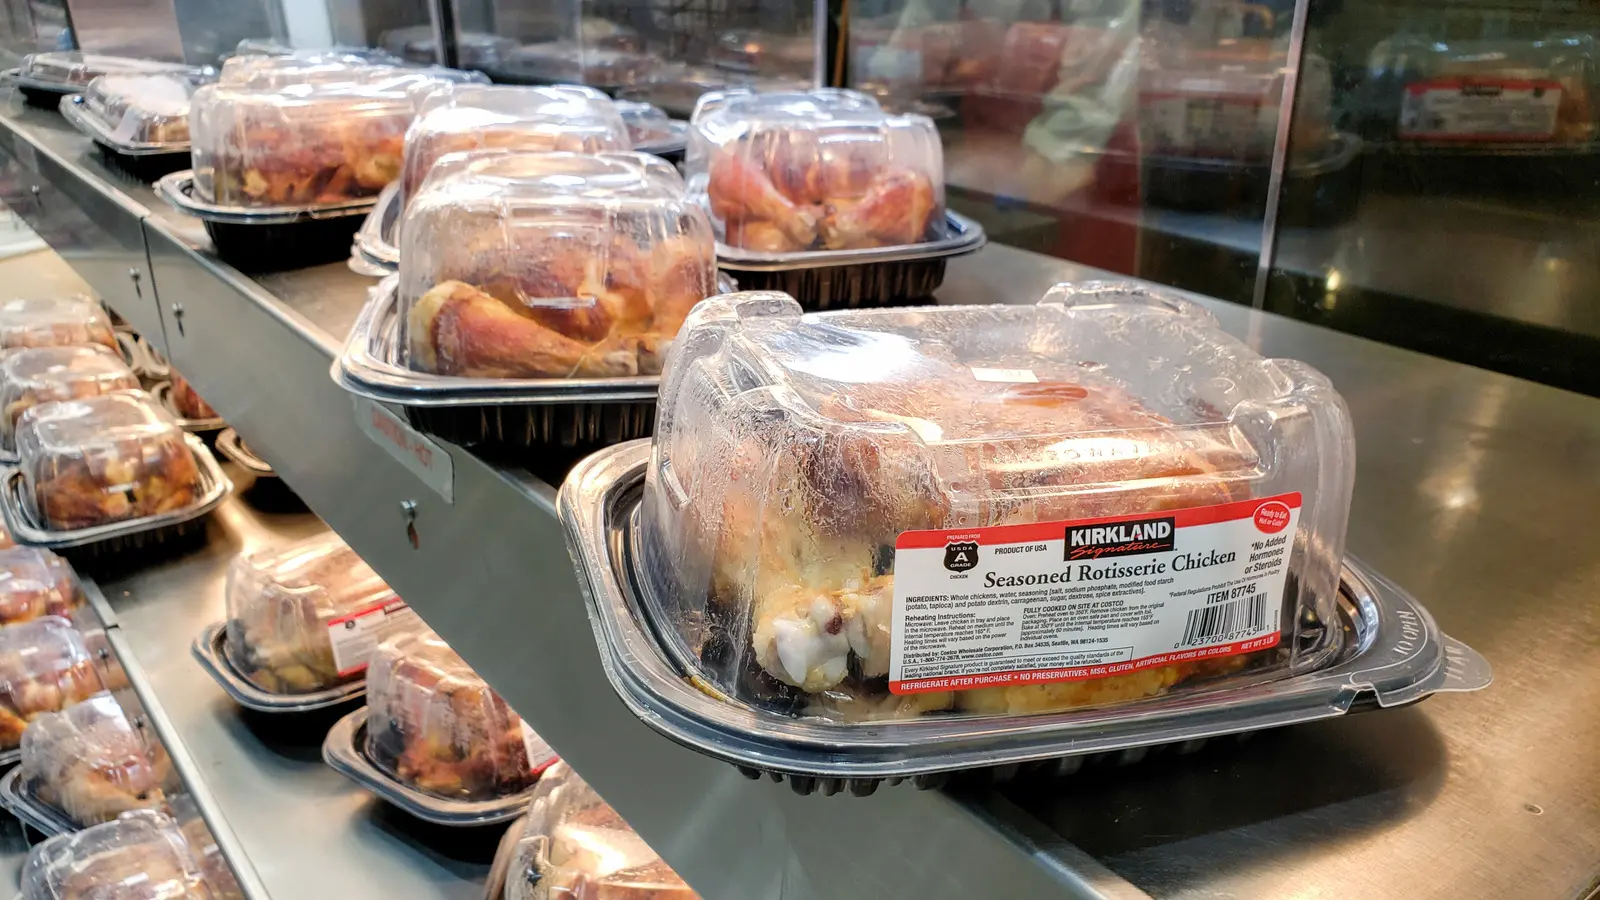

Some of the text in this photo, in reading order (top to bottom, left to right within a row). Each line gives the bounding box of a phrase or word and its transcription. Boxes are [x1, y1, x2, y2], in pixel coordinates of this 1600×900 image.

[1261, 508, 1274, 518] Ready
[1071, 521, 1171, 546] KIRKLAND
[1264, 535, 1287, 548] Added
[954, 552, 968, 562] A
[994, 546, 1024, 555] PRODUCT
[1069, 541, 1171, 560] Signature
[1249, 547, 1284, 562] Hormones
[984, 550, 1236, 588] Seasoned Rotisserie Chicken
[1244, 558, 1282, 574] or Steroids
[1087, 584, 1117, 592] phosphate,
[1207, 583, 1256, 604] ITEM 87745
[1192, 634, 1224, 646] 23700
[1228, 627, 1257, 640] 87745
[901, 680, 948, 690] REFRIGERATE
[950, 678, 973, 686] AFTER
[974, 674, 1012, 684] PURCHASE
[1032, 669, 1088, 679] PRESERVATIVES,
[1108, 663, 1134, 672] GLUTEN,
[1135, 656, 1168, 668] ARTIFICIAL
[1169, 651, 1196, 661] FLAVORS
[1208, 646, 1232, 656] COLORS
